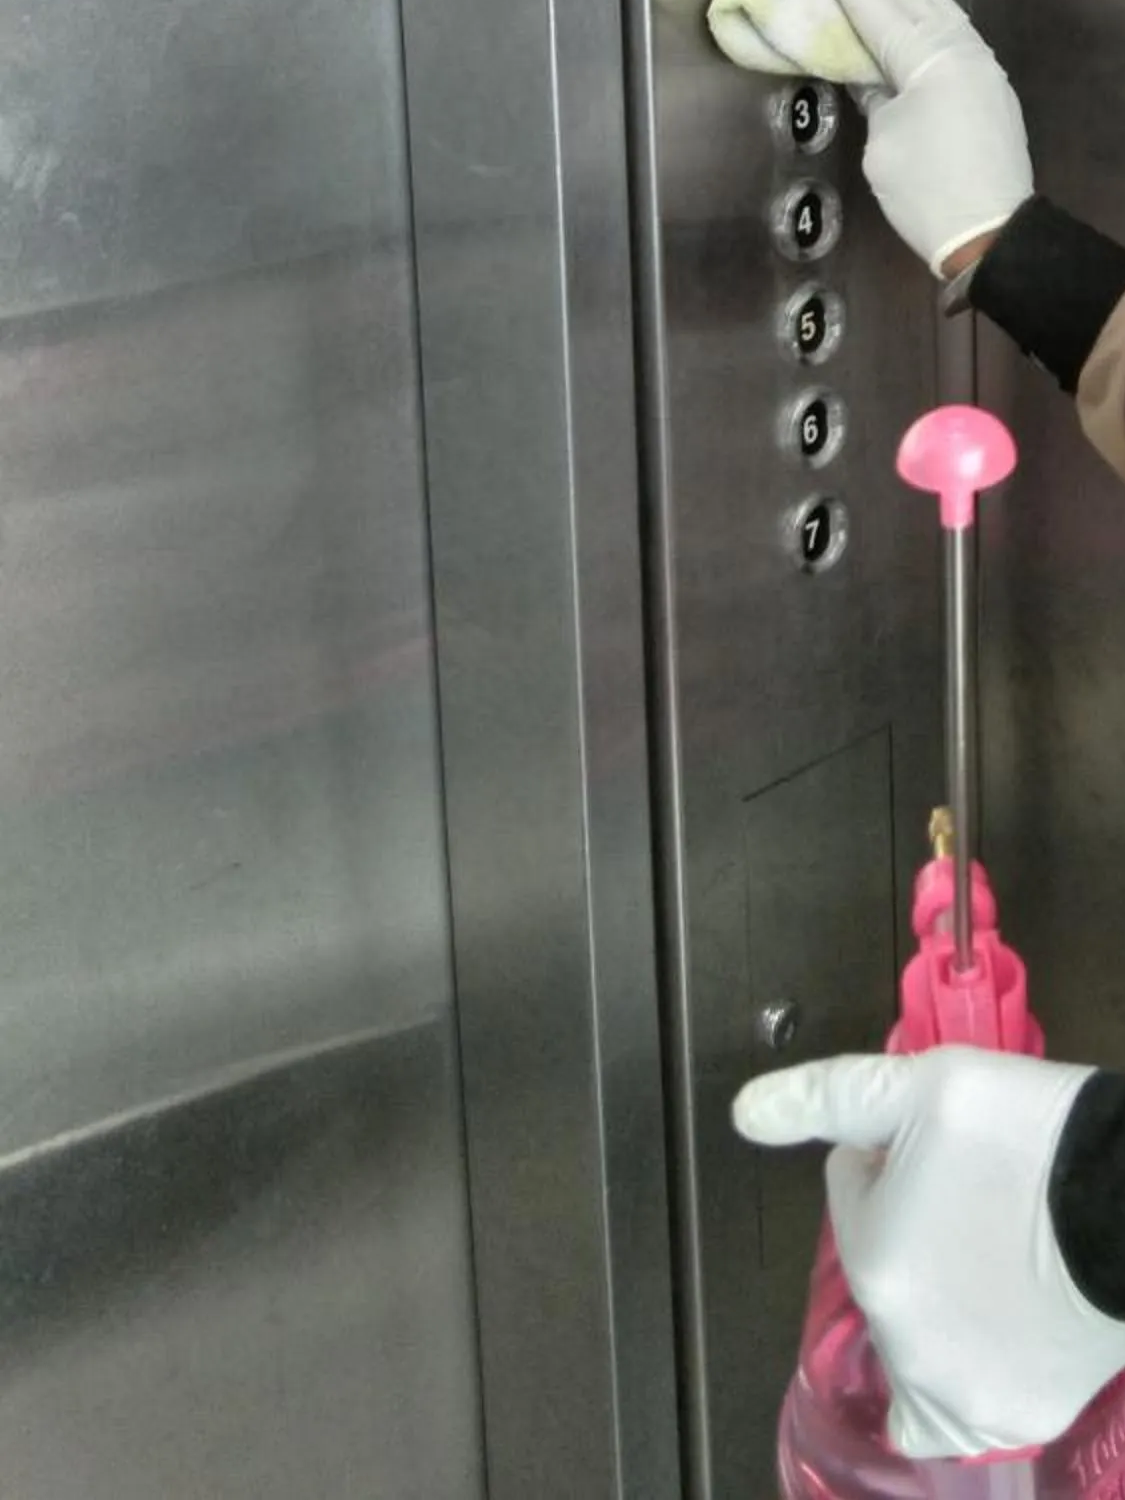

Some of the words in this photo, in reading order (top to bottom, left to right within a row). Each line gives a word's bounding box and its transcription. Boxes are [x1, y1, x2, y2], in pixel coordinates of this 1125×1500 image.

[794, 99, 811, 129] 3
[798, 206, 813, 235] 4
[801, 311, 817, 341] 5
[803, 415, 819, 444] 6
[805, 518, 821, 549] 7
